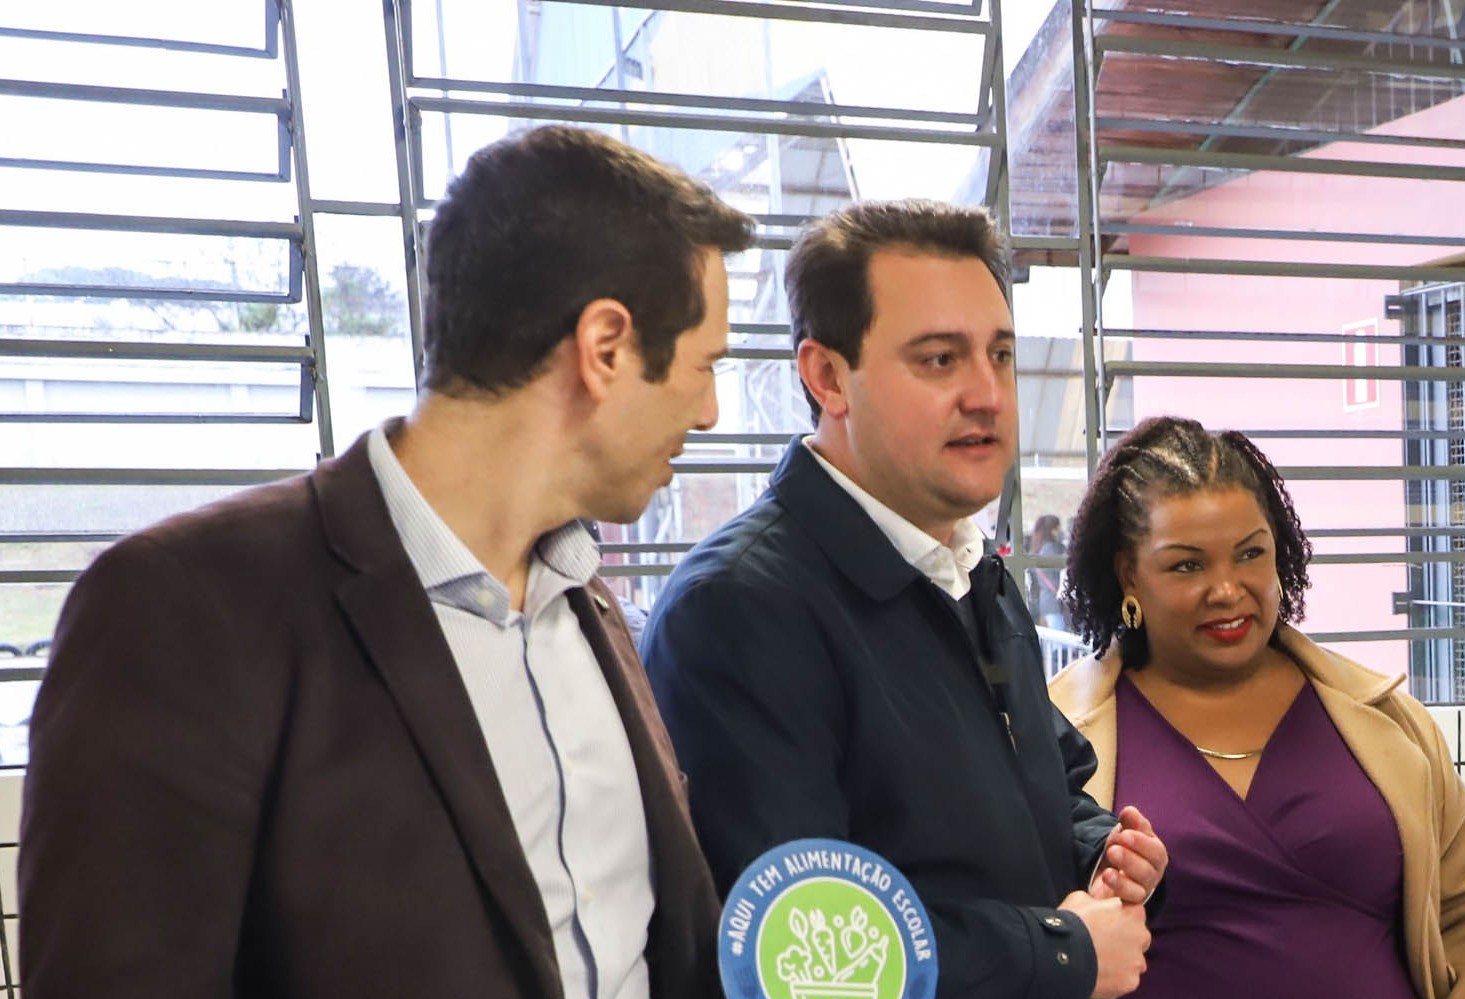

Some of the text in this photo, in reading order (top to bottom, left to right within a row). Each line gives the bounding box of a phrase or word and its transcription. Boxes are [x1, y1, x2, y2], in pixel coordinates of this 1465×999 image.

[727, 850, 931, 962] #AQUI TEM ALIMENTAÇÃO ESCOLAR
